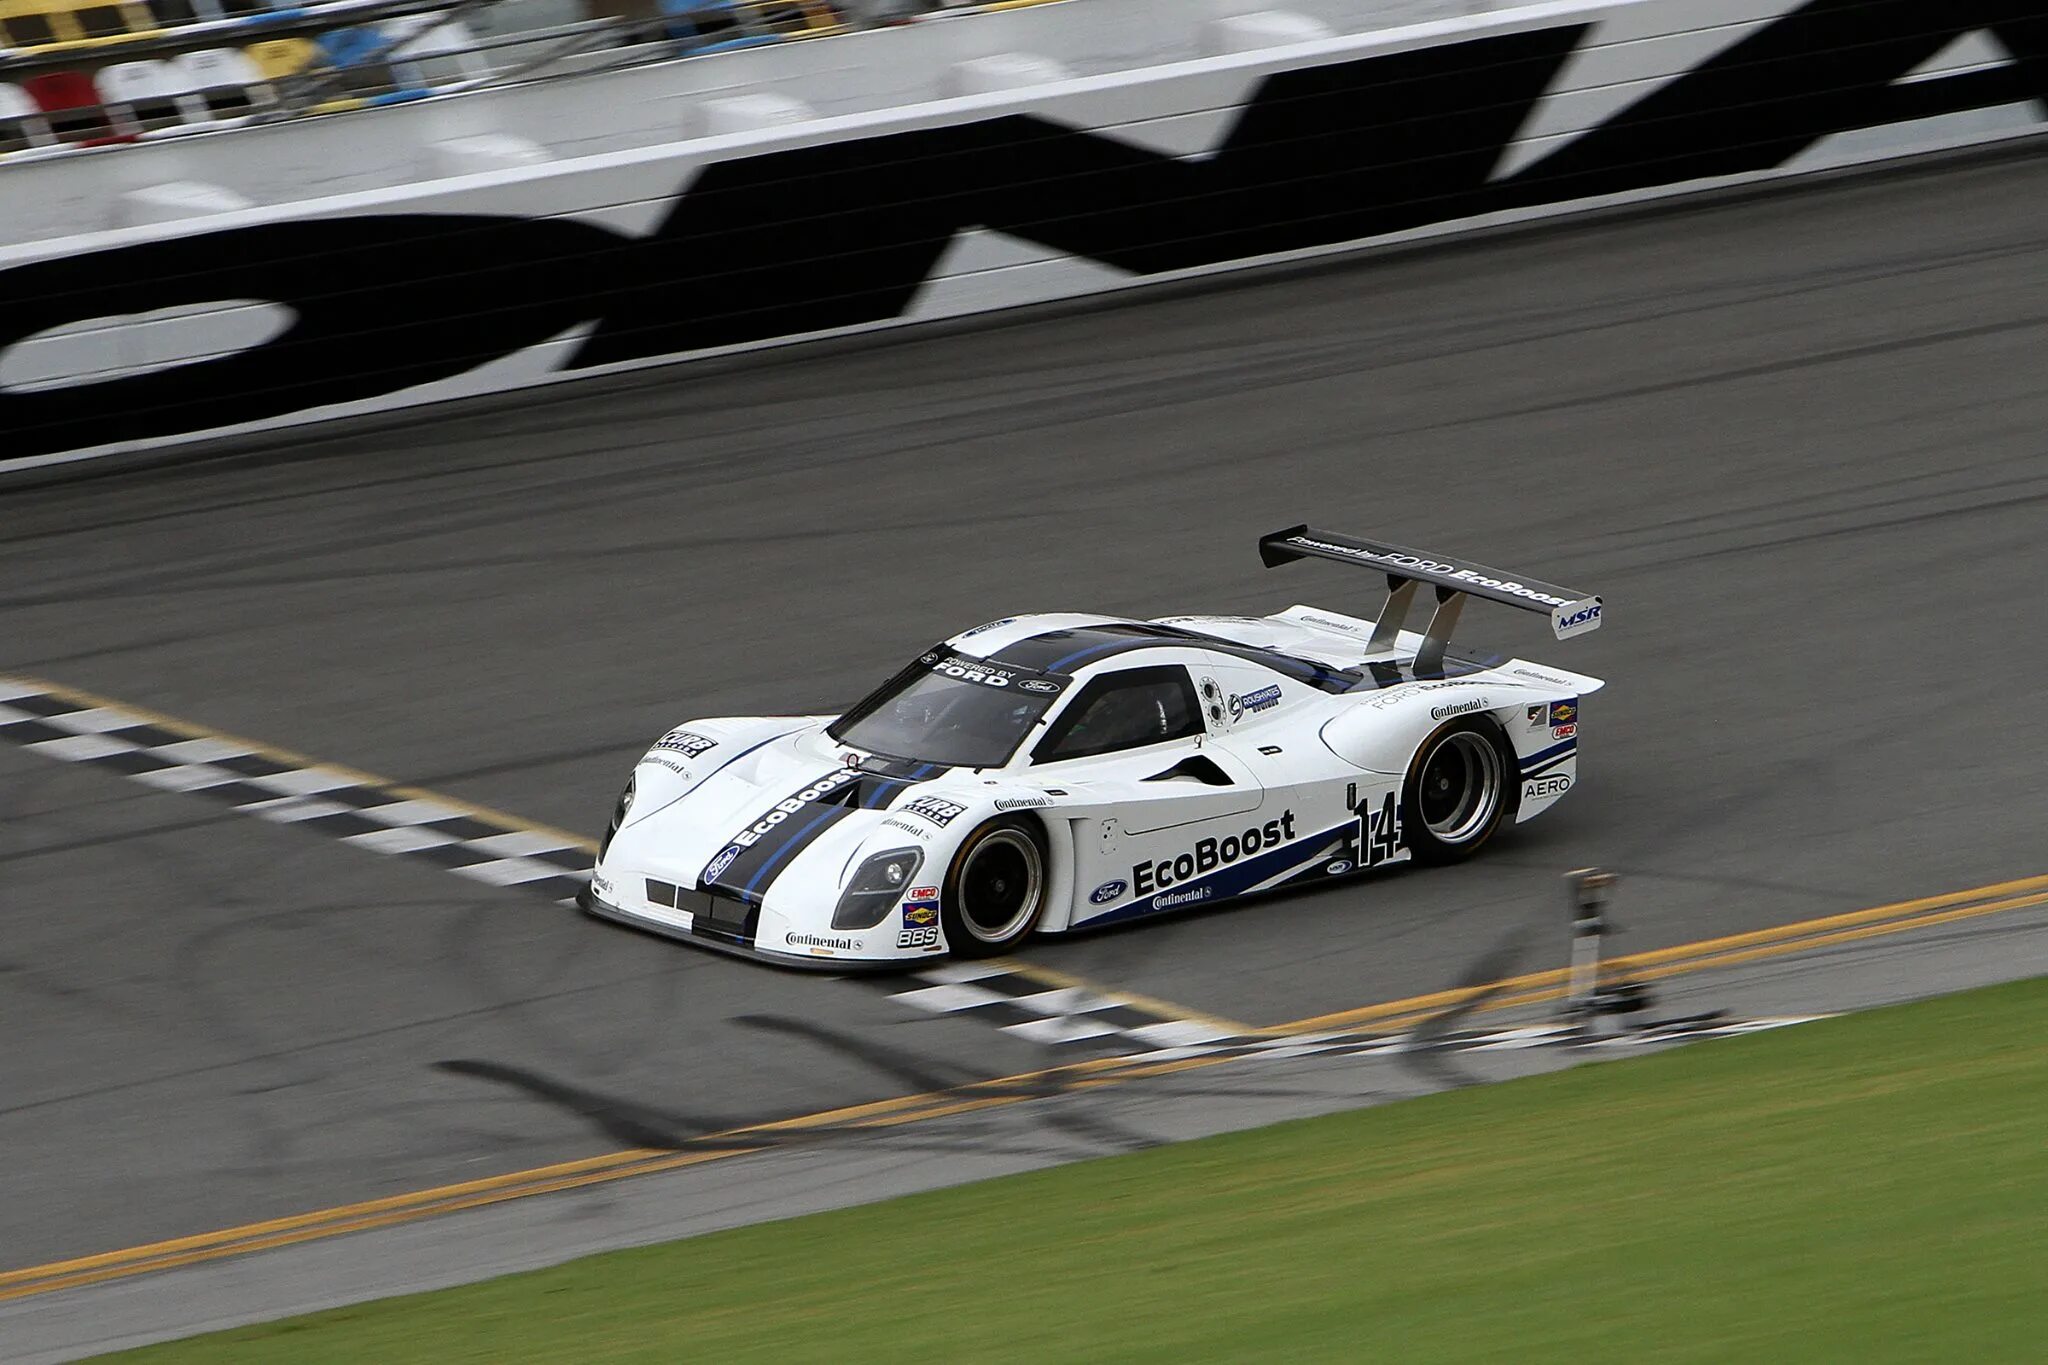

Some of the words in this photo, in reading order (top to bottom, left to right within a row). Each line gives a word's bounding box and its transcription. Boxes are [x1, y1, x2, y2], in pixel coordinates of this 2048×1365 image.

[1286, 536, 1361, 554] Powered
[1377, 552, 1454, 574] FORD
[1449, 569, 1578, 607] EcoBoost
[1558, 606, 1602, 630] MSR
[932, 661, 1009, 687] FORD
[943, 656, 996, 674] POWERED
[996, 669, 1016, 678] BY
[1024, 679, 1053, 691] Ford
[1431, 698, 1482, 720] Continental
[1525, 778, 1570, 798] AERO
[994, 797, 1047, 812] Continental
[1353, 790, 1400, 867] 14
[709, 850, 734, 877] Ford
[1132, 808, 1296, 898] EcoBoost
[911, 888, 937, 898] EMCO
[1096, 883, 1121, 902] Ford
[1152, 887, 1204, 911] Continental
[785, 931, 851, 950] Continental
[896, 927, 938, 948] BBS
